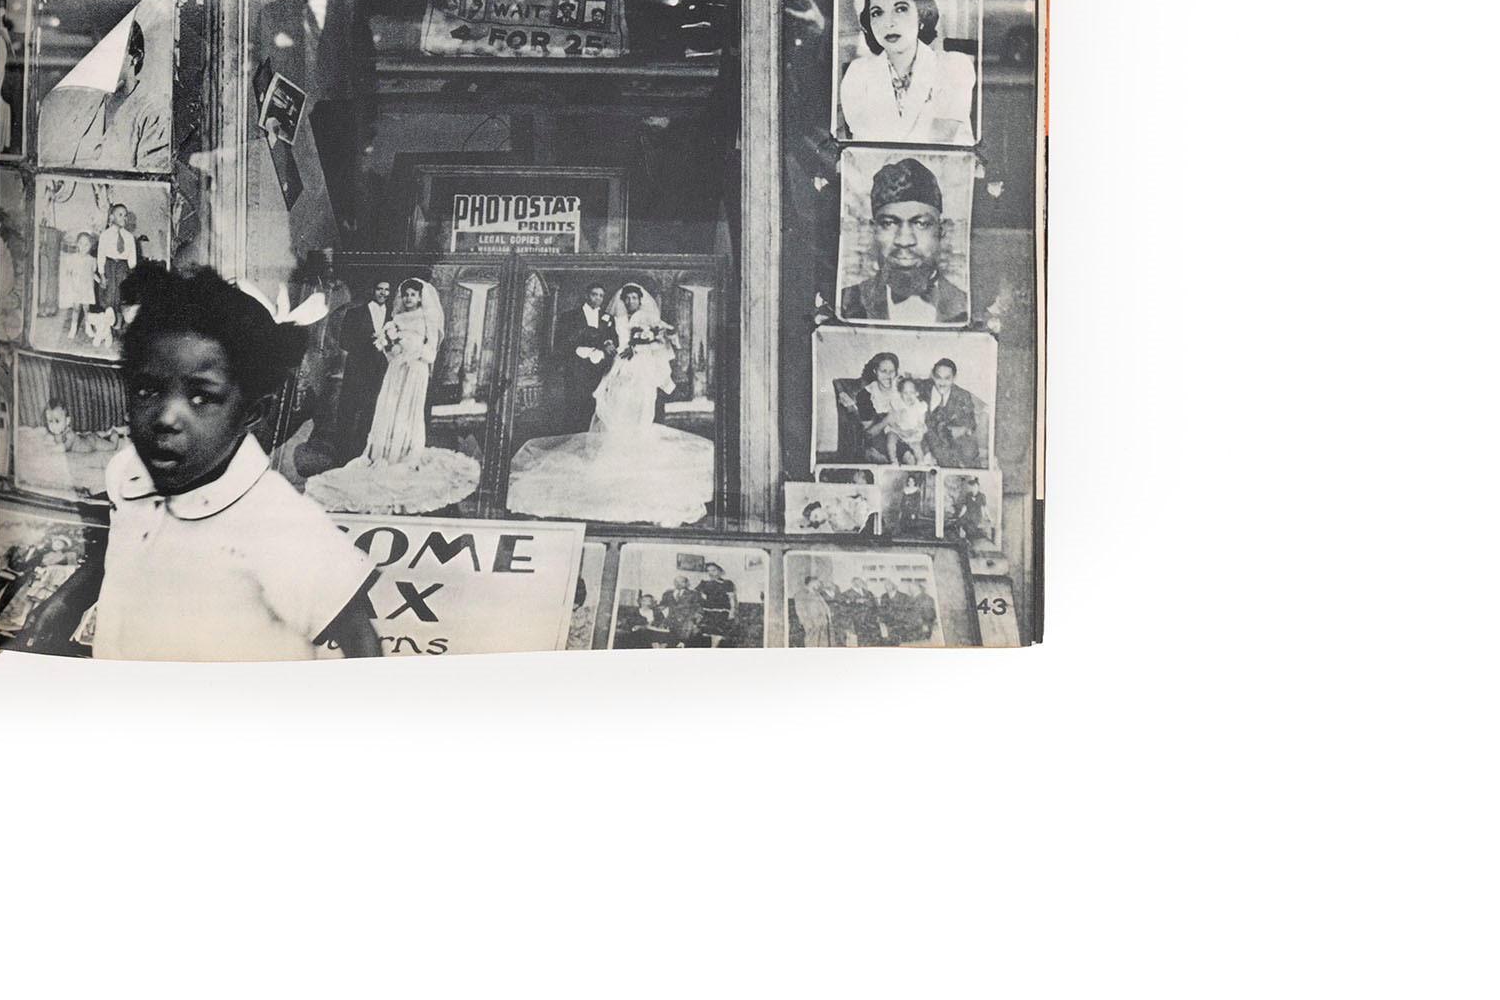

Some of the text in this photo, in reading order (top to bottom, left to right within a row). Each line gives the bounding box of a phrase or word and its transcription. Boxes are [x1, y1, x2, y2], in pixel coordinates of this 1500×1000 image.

[492, 3, 546, 19] WAIT
[488, 27, 551, 52] FOR
[454, 195, 578, 231] PHOTOSTAT
[478, 235, 506, 245] LEGAL
[509, 235, 540, 245] COPIES
[336, 525, 535, 574] OME
[976, 597, 1008, 616] 43
